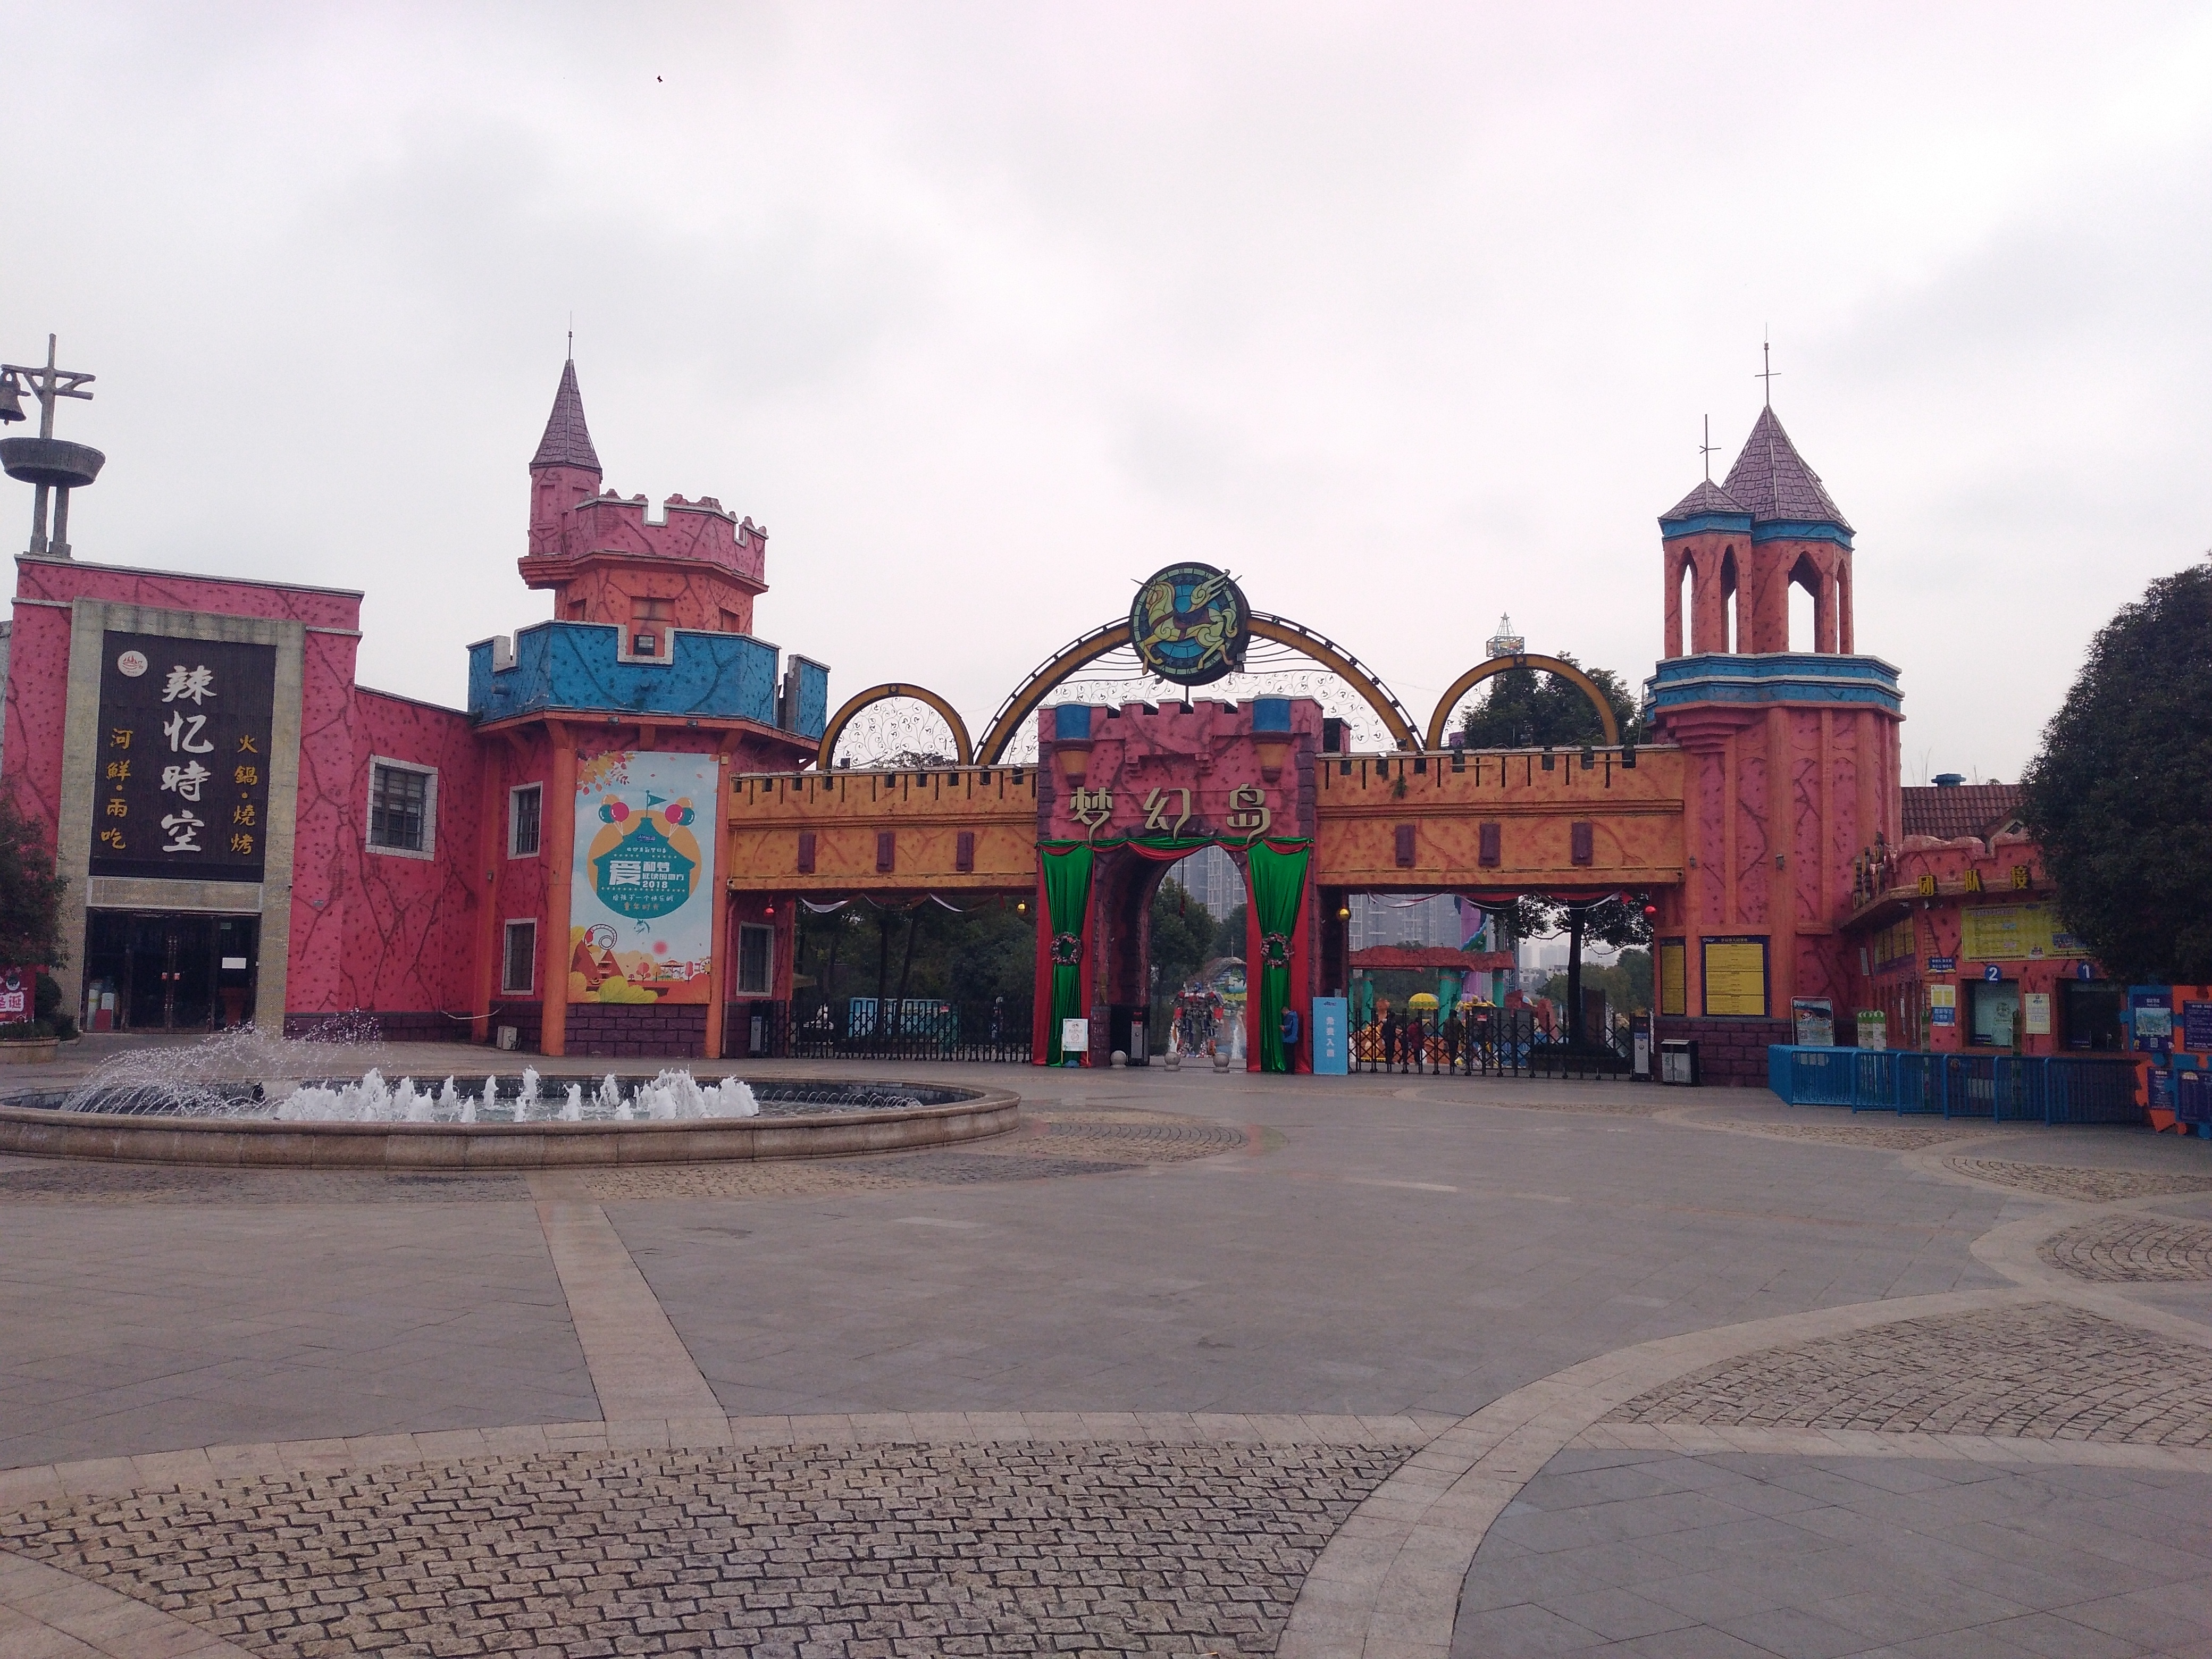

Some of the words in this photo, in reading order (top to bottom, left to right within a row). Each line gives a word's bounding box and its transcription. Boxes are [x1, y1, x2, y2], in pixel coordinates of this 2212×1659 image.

[161, 665, 217, 852] 辣忆時空
[1069, 783, 1271, 847] 梦幻岛
[609, 860, 641, 886] 爱
[1989, 967, 1998, 981] 2
[2082, 963, 2090, 979] 1
